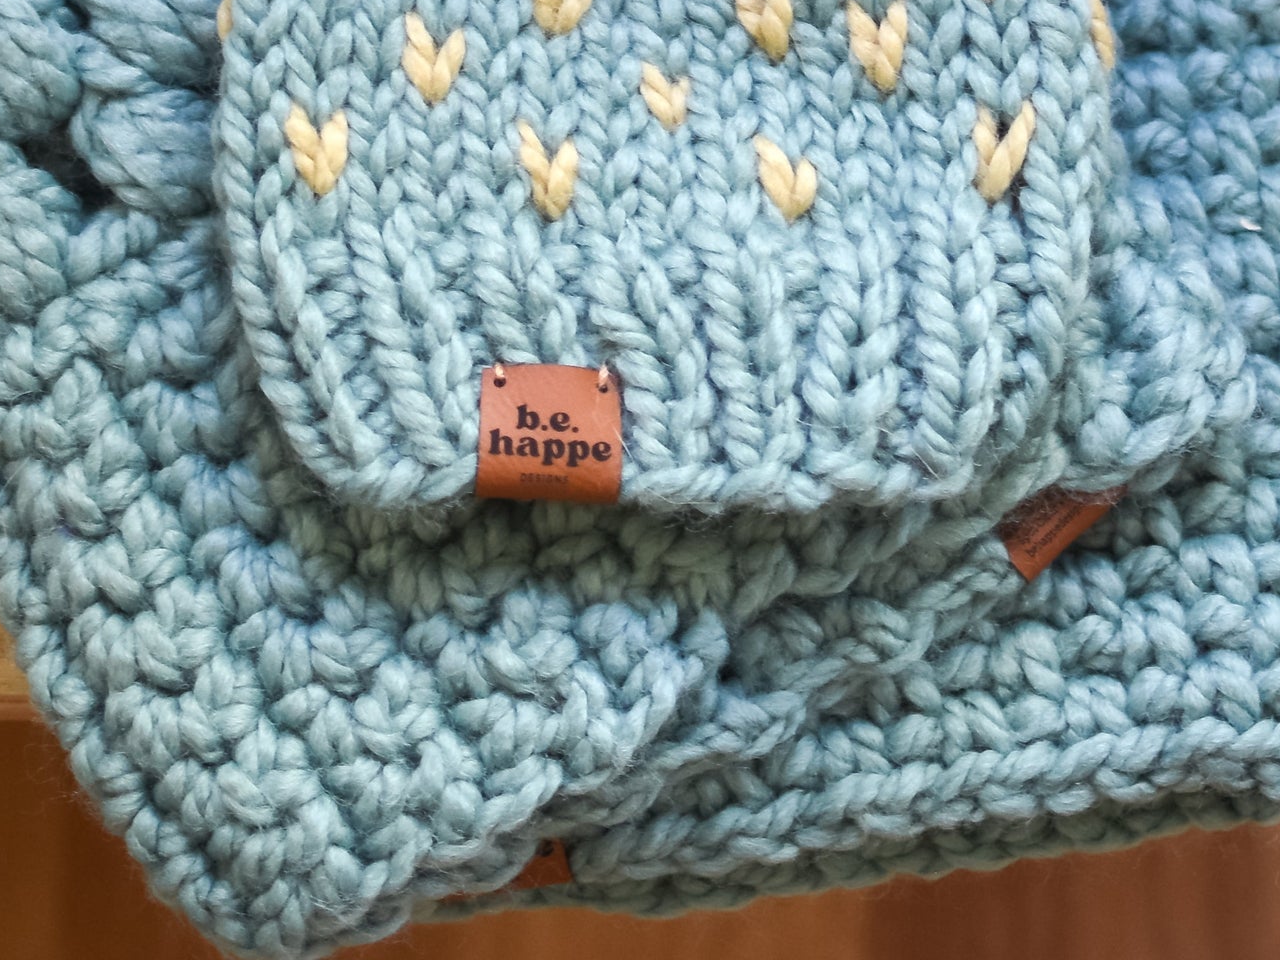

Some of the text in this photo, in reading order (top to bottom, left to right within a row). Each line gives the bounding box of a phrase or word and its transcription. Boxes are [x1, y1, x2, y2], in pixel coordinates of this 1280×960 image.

[516, 403, 579, 433] b.e.
[488, 428, 612, 467] happe
[520, 473, 569, 484] DESIGNS
